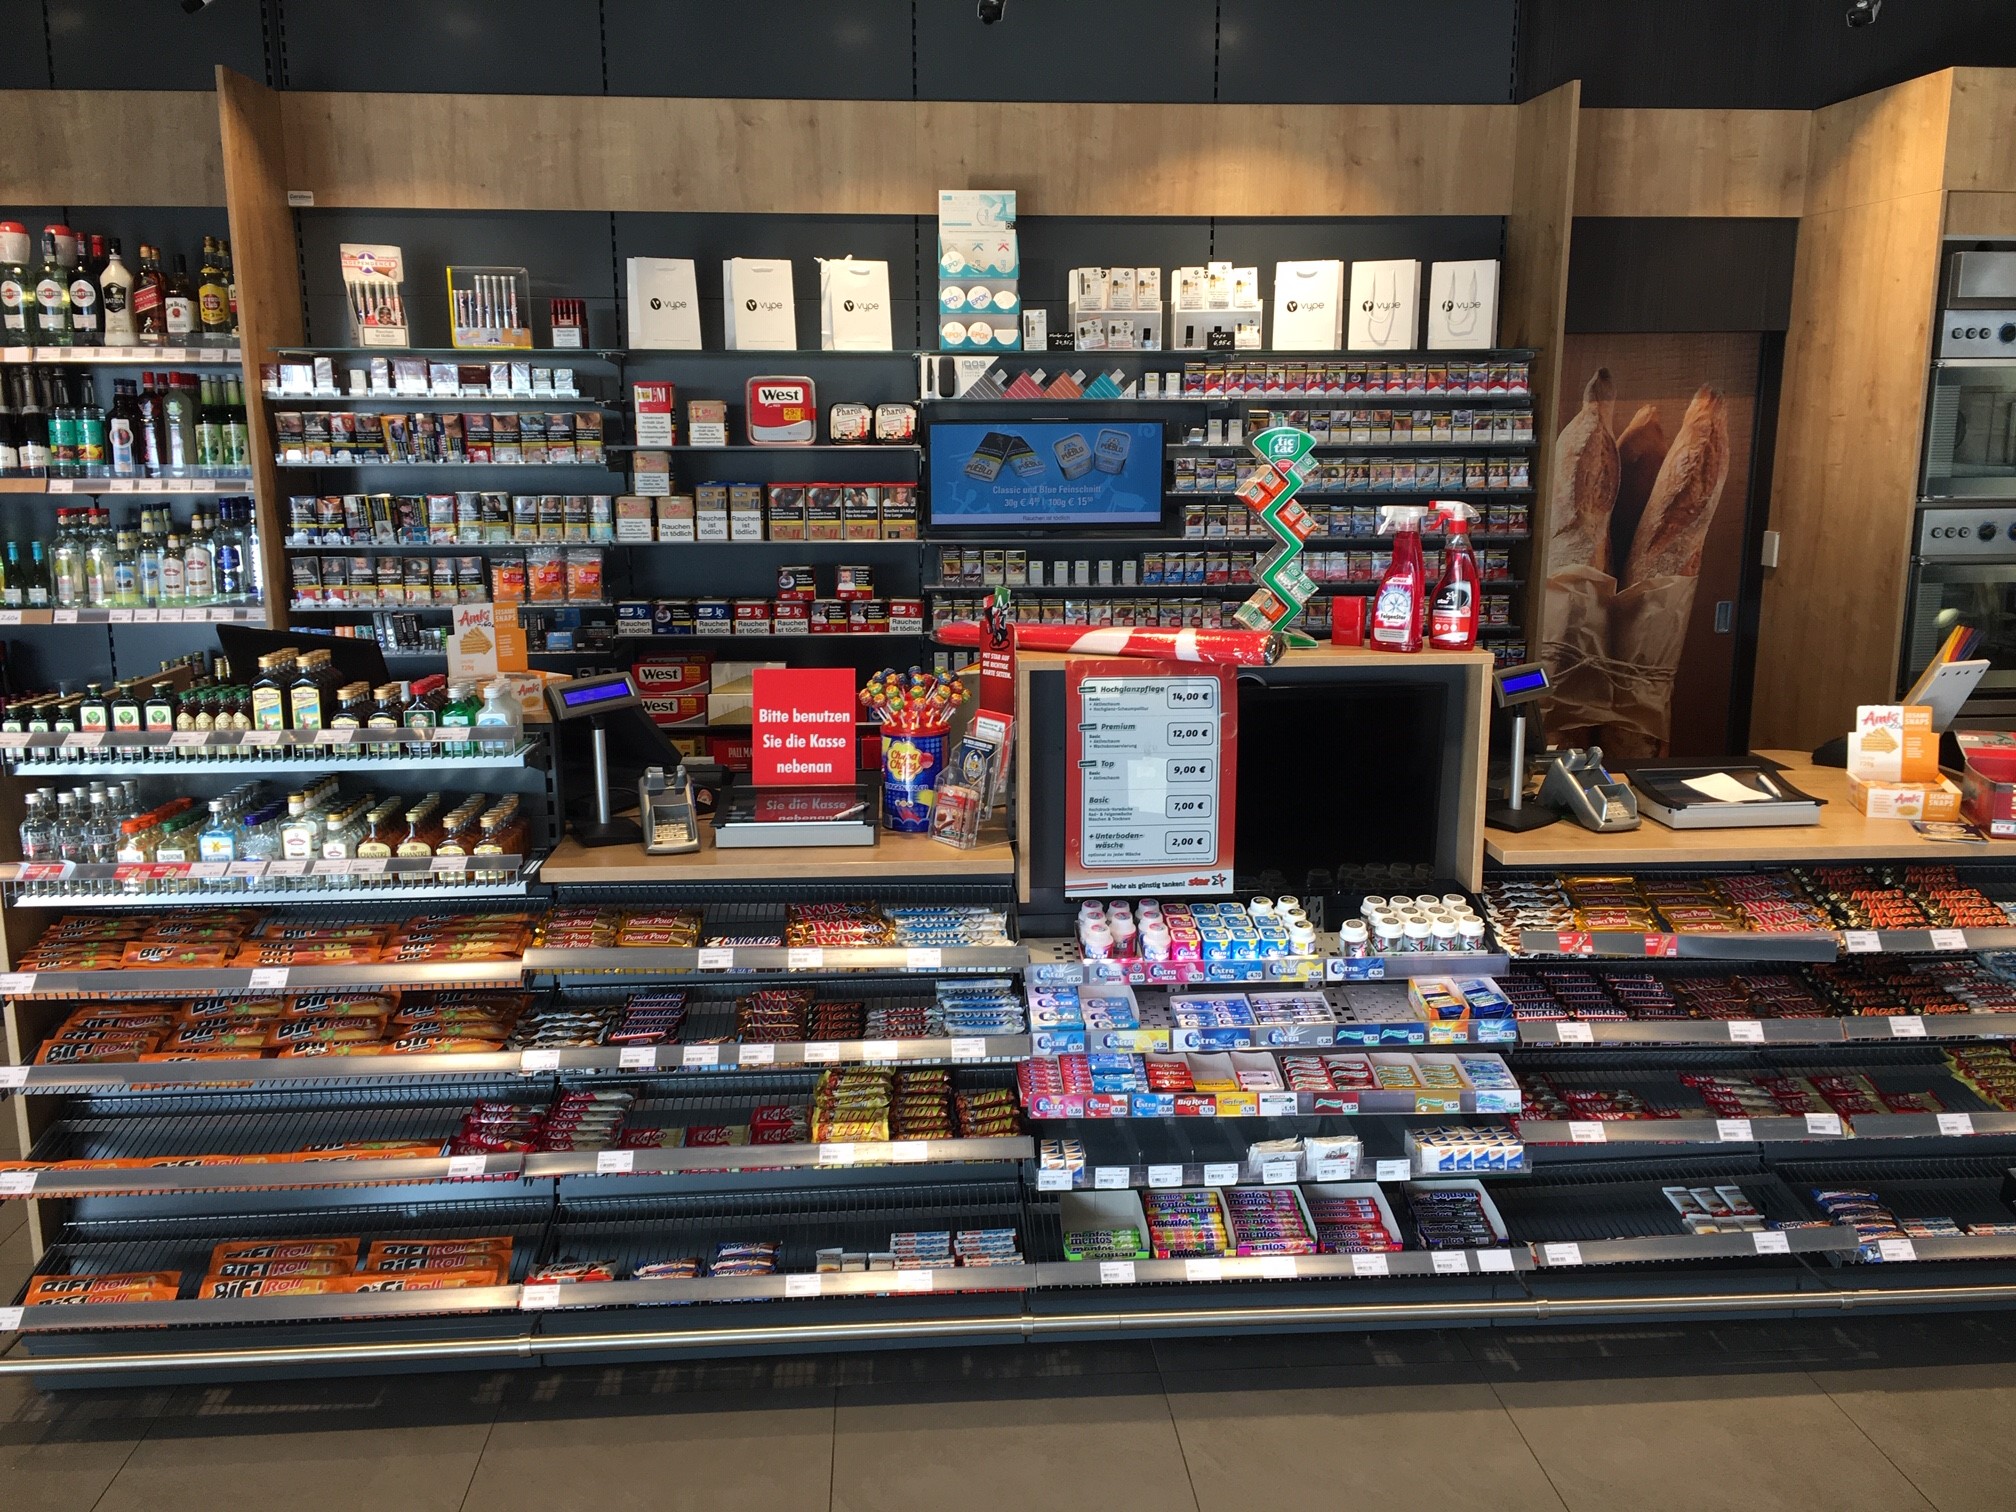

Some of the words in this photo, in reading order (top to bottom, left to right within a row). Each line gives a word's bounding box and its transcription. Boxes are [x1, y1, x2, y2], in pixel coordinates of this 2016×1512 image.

[971, 291, 988, 305] EPOK
[663, 299, 687, 311] vype
[759, 300, 782, 311] vype
[1300, 302, 1324, 311] vype
[971, 331, 988, 339] EPOK
[762, 389, 800, 401] West
[1277, 437, 1295, 446] tic
[1101, 442, 1123, 453] PUEBLO
[1274, 445, 1294, 453] tac
[1062, 447, 1084, 460] PUEBLO
[993, 486, 1020, 494] Classic
[1059, 485, 1101, 493] Feinschnitt
[503, 570, 509, 578] 6
[538, 569, 545, 578] 6
[990, 662, 1008, 670] RICHTIGE
[642, 669, 678, 680] West
[1100, 686, 1165, 694] Hochglanzpflege
[1172, 692, 1198, 702] 14,00
[759, 709, 789, 722] Bitte
[793, 708, 850, 722] benutzen
[1905, 718, 1929, 726] SNAPS
[1173, 729, 1198, 739] 12,00
[1202, 729, 1208, 737] €
[763, 734, 782, 748] Sie
[786, 734, 806, 748] die
[810, 734, 846, 748] Kasse
[728, 748, 742, 758] PALL
[777, 759, 832, 773] nebenan
[1101, 760, 1114, 768] Top
[1173, 766, 1196, 776] 9,00
[1199, 766, 1206, 774] €
[766, 800, 782, 810] Sie
[786, 799, 807, 810] die
[810, 799, 847, 810] Kasse
[1089, 796, 1109, 804] Basic
[1928, 799, 1954, 807] SNAPS
[1174, 802, 1194, 812] 7,00
[1095, 832, 1144, 840] Unterboden-
[1095, 841, 1124, 849] wäsche
[1172, 838, 1193, 847] 2,00
[1138, 882, 1160, 890] günstig
[1162, 880, 1185, 888] tanken!
[1188, 878, 1210, 886] star
[1851, 890, 1904, 900] Mars
[1930, 890, 1983, 899] Mars
[795, 903, 847, 914] TWIX
[1671, 910, 1692, 919] PRINCE
[1692, 909, 1711, 918] POLO
[629, 918, 652, 926] PRINCE
[653, 917, 673, 925] POLO
[1872, 916, 1925, 927] Mars
[811, 920, 863, 935] TWIX
[624, 934, 648, 943] PRINCE
[649, 933, 669, 941] POLO
[813, 934, 864, 944] TWIX
[1152, 967, 1177, 977] Extra
[1211, 967, 1235, 976] Extra
[1518, 1009, 1566, 1018] SNICKERS
[1579, 1008, 1626, 1018] SNICKERS
[1189, 1035, 1216, 1045] Extra
[908, 1071, 944, 1082] LION
[972, 1092, 1008, 1105] LION
[761, 1109, 797, 1121] KitKat
[834, 1122, 873, 1136] LION
[633, 1131, 667, 1145] KitKat
[698, 1127, 733, 1143] KitKat
[1153, 1219, 1195, 1227] mentos
[1249, 1242, 1286, 1251] entos
[429, 1254, 466, 1269] Roll
[272, 1260, 309, 1275] Roll
[550, 1262, 588, 1273] bueno
[213, 1278, 266, 1299] BiFi
[265, 1277, 303, 1293] Roll
